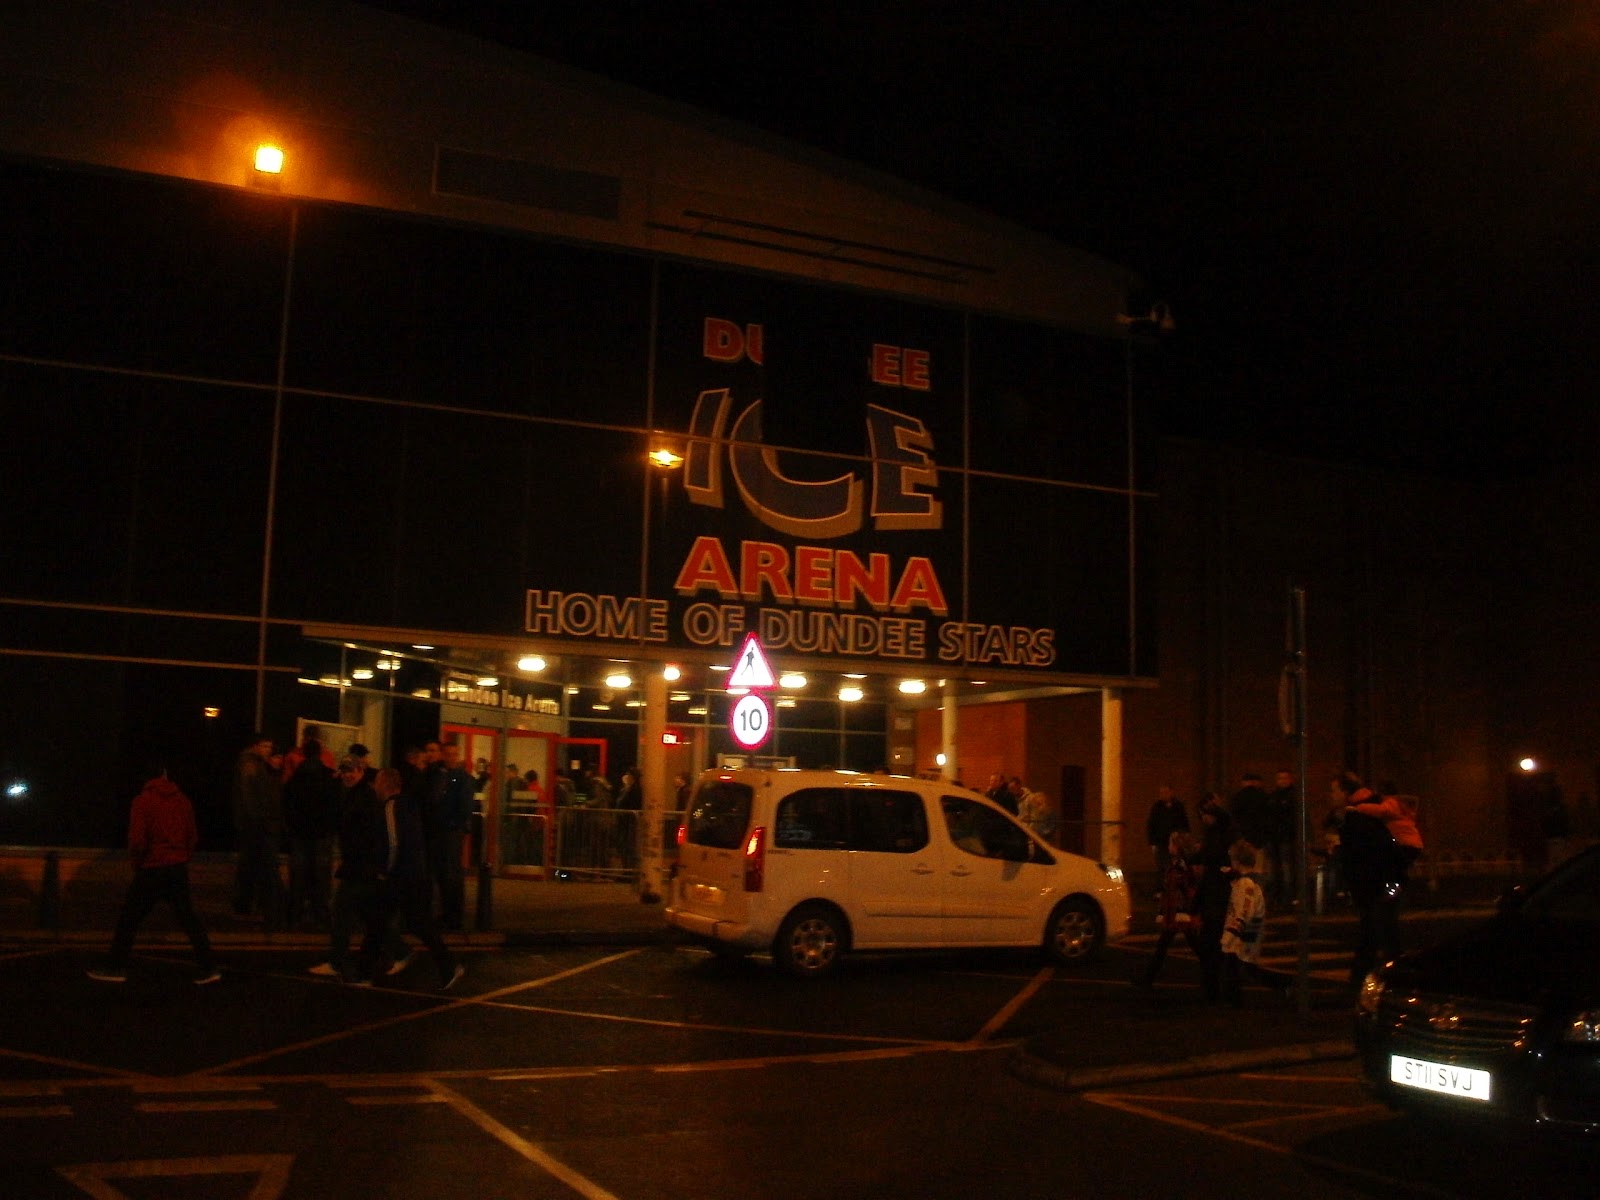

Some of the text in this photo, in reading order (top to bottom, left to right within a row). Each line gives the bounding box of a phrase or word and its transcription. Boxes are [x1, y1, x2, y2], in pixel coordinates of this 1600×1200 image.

[684, 388, 943, 539] ICE
[674, 535, 948, 616] ARENA
[525, 589, 1056, 667] HOME OF DUNDEE STARS
[740, 708, 762, 731] 10
[1438, 1068, 1473, 1091] SVJ
